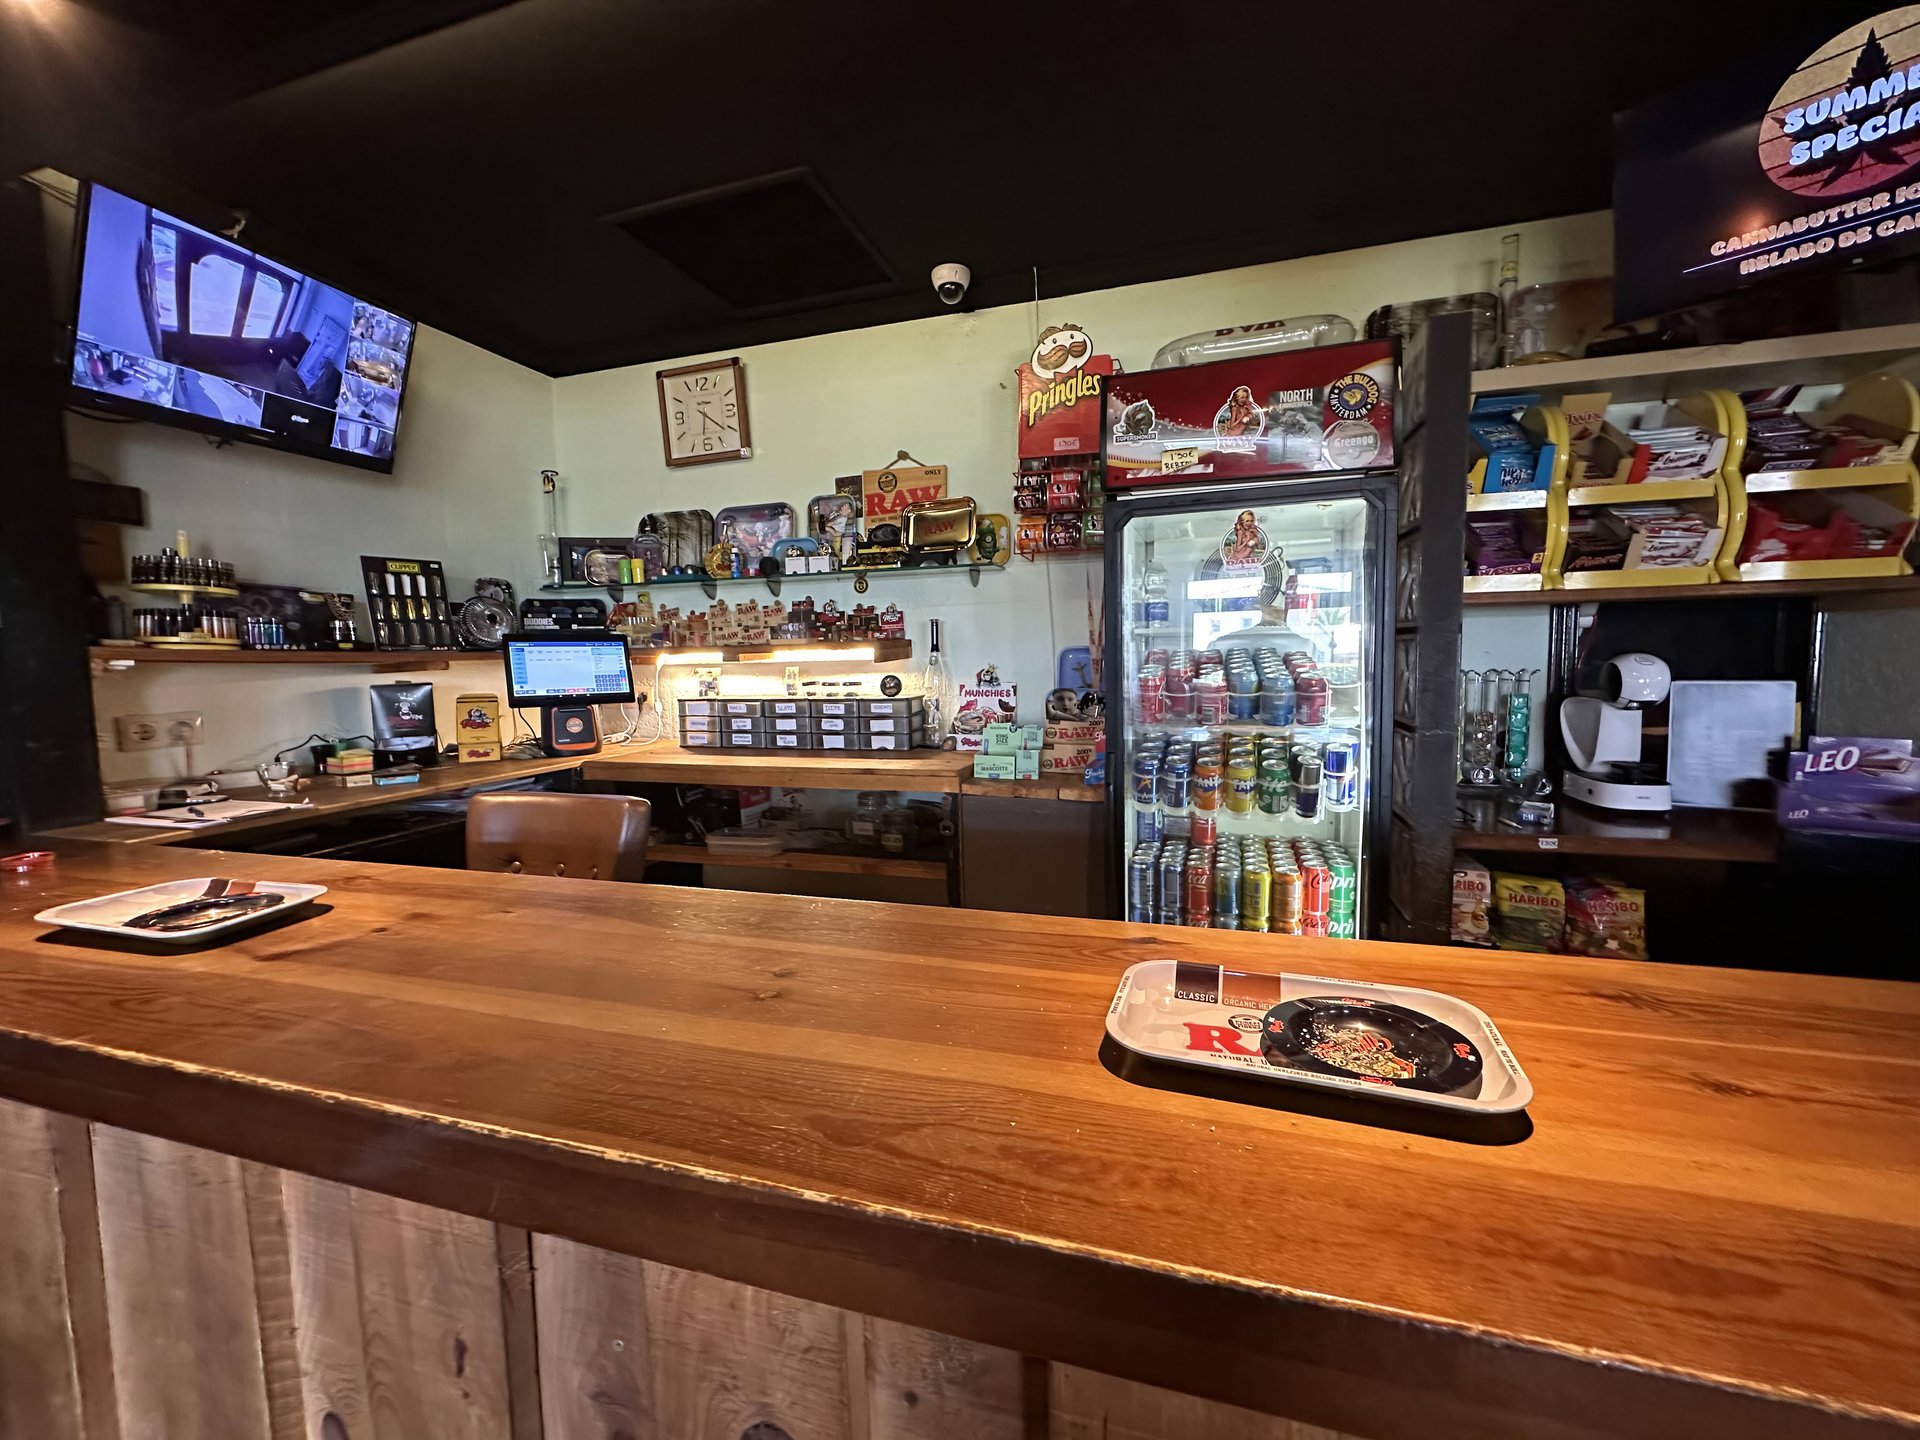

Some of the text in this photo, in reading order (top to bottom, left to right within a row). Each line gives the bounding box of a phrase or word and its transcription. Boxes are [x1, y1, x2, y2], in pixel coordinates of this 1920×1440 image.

[1710, 191, 1891, 256] CANNABUTTER
[1838, 225, 1873, 248] DE
[695, 376, 709, 392] 12
[1335, 373, 1379, 405] THE BULLDOG
[1029, 369, 1100, 427] Pringles
[1279, 387, 1314, 403] NORTH
[725, 403, 736, 418] 3
[1329, 392, 1370, 420] AMSTERDAM
[675, 411, 685, 426] 9
[703, 437, 713, 451] 6
[1116, 433, 1157, 443] SUPERSMOKER
[1333, 435, 1374, 448] Greengo
[864, 484, 943, 517] RAW
[924, 519, 956, 537] RAW
[737, 604, 757, 615] RAW
[721, 631, 740, 641] RAW
[746, 630, 766, 642] RAW
[964, 689, 1012, 698] MUNCHIES
[1053, 755, 1090, 770] RAW
[1803, 746, 1860, 773] LEO
[1788, 809, 1809, 819] LEO
[1508, 892, 1560, 908] HARIBO
[1588, 900, 1640, 913] HARIBO
[1177, 989, 1215, 1003] CLASSIC
[1223, 997, 1257, 1010] ORGANIC
